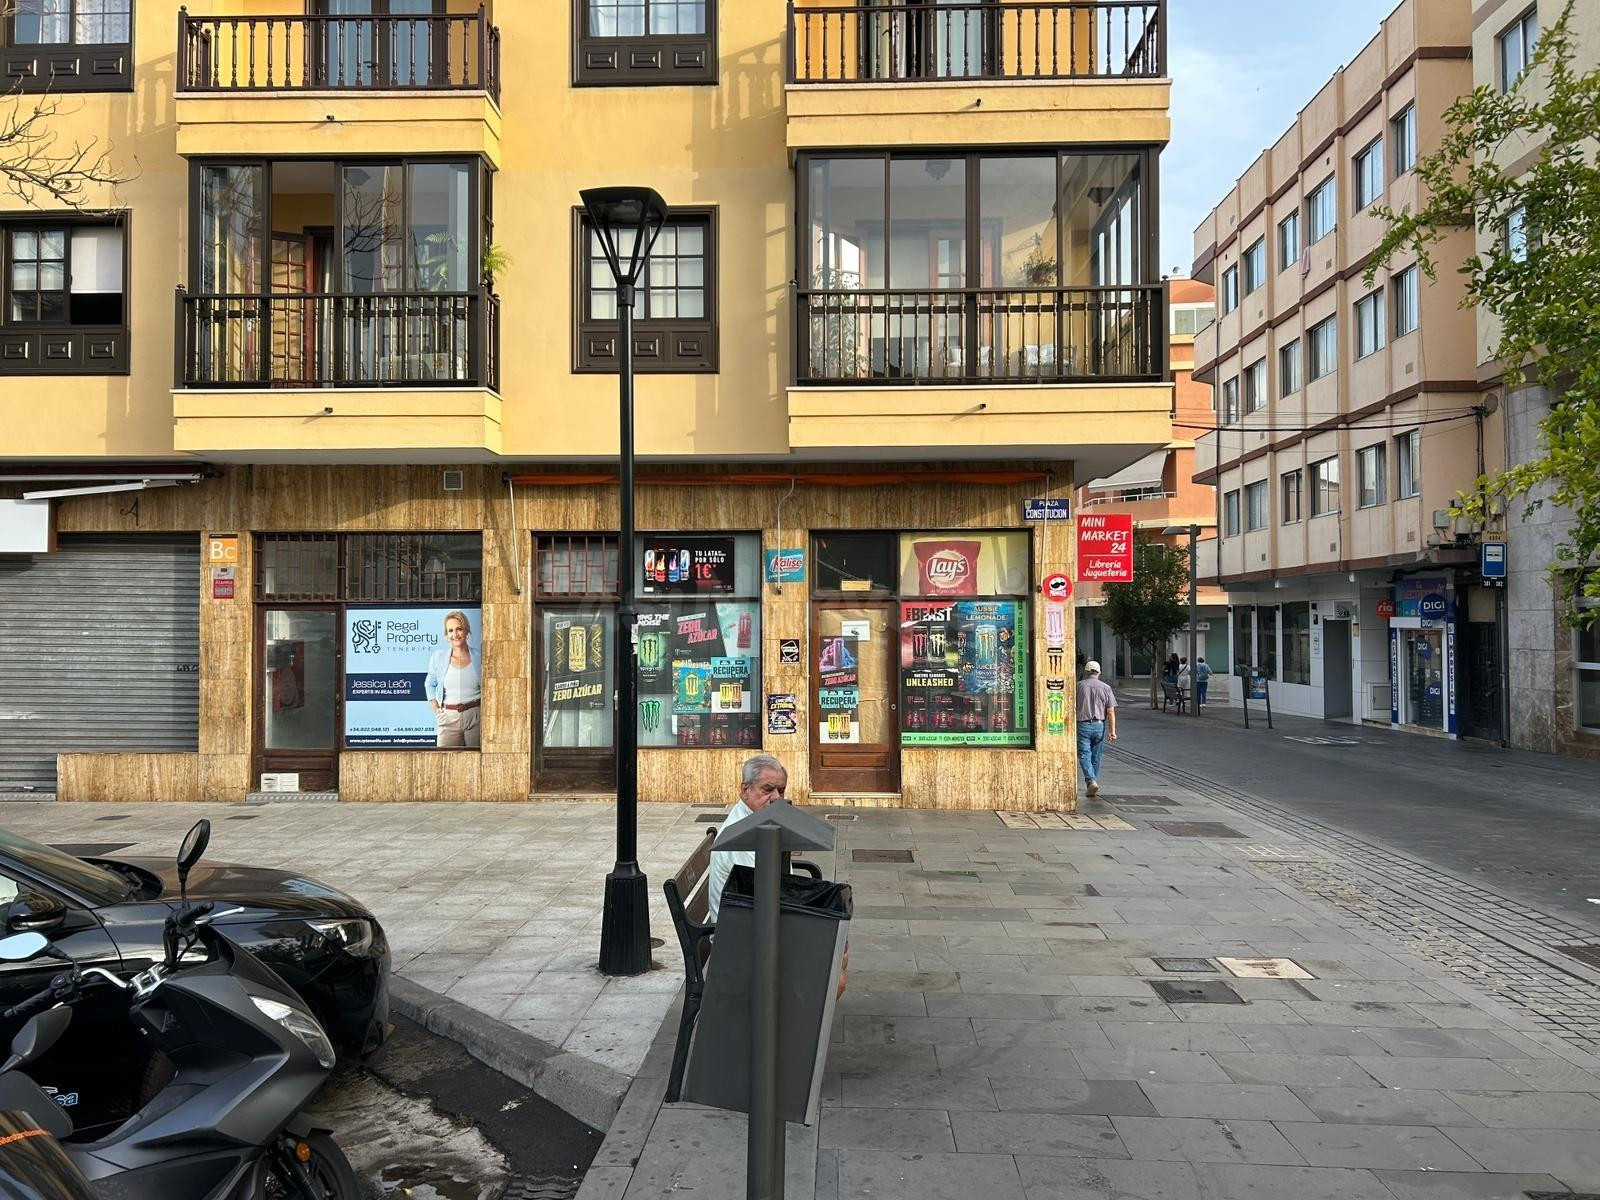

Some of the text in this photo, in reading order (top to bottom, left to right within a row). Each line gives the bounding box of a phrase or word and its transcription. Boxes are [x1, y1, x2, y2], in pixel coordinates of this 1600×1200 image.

[1025, 509, 1066, 519] CONSTTUCION
[1081, 517, 1106, 527] MINI
[1081, 531, 1129, 541] MARKET
[211, 541, 235, 560] Bc
[1110, 543, 1127, 553] 24
[930, 556, 966, 581] Lay's
[1089, 560, 1121, 569] Librería
[1083, 568, 1127, 579] Juguetería
[1378, 602, 1393, 612] ria
[1424, 602, 1445, 610] DIGI
[912, 608, 952, 622] BEAST
[386, 620, 419, 634] Regal
[677, 620, 701, 634] ZERO
[386, 633, 438, 645] Property
[688, 628, 718, 644] AZÚCAR
[713, 666, 748, 676] RECUPERA
[352, 678, 412, 688] Jessica León
[906, 678, 954, 686] UNLEASHED
[552, 684, 602, 702] ZERO AZÚCAR
[821, 696, 856, 705] RECUPERA
